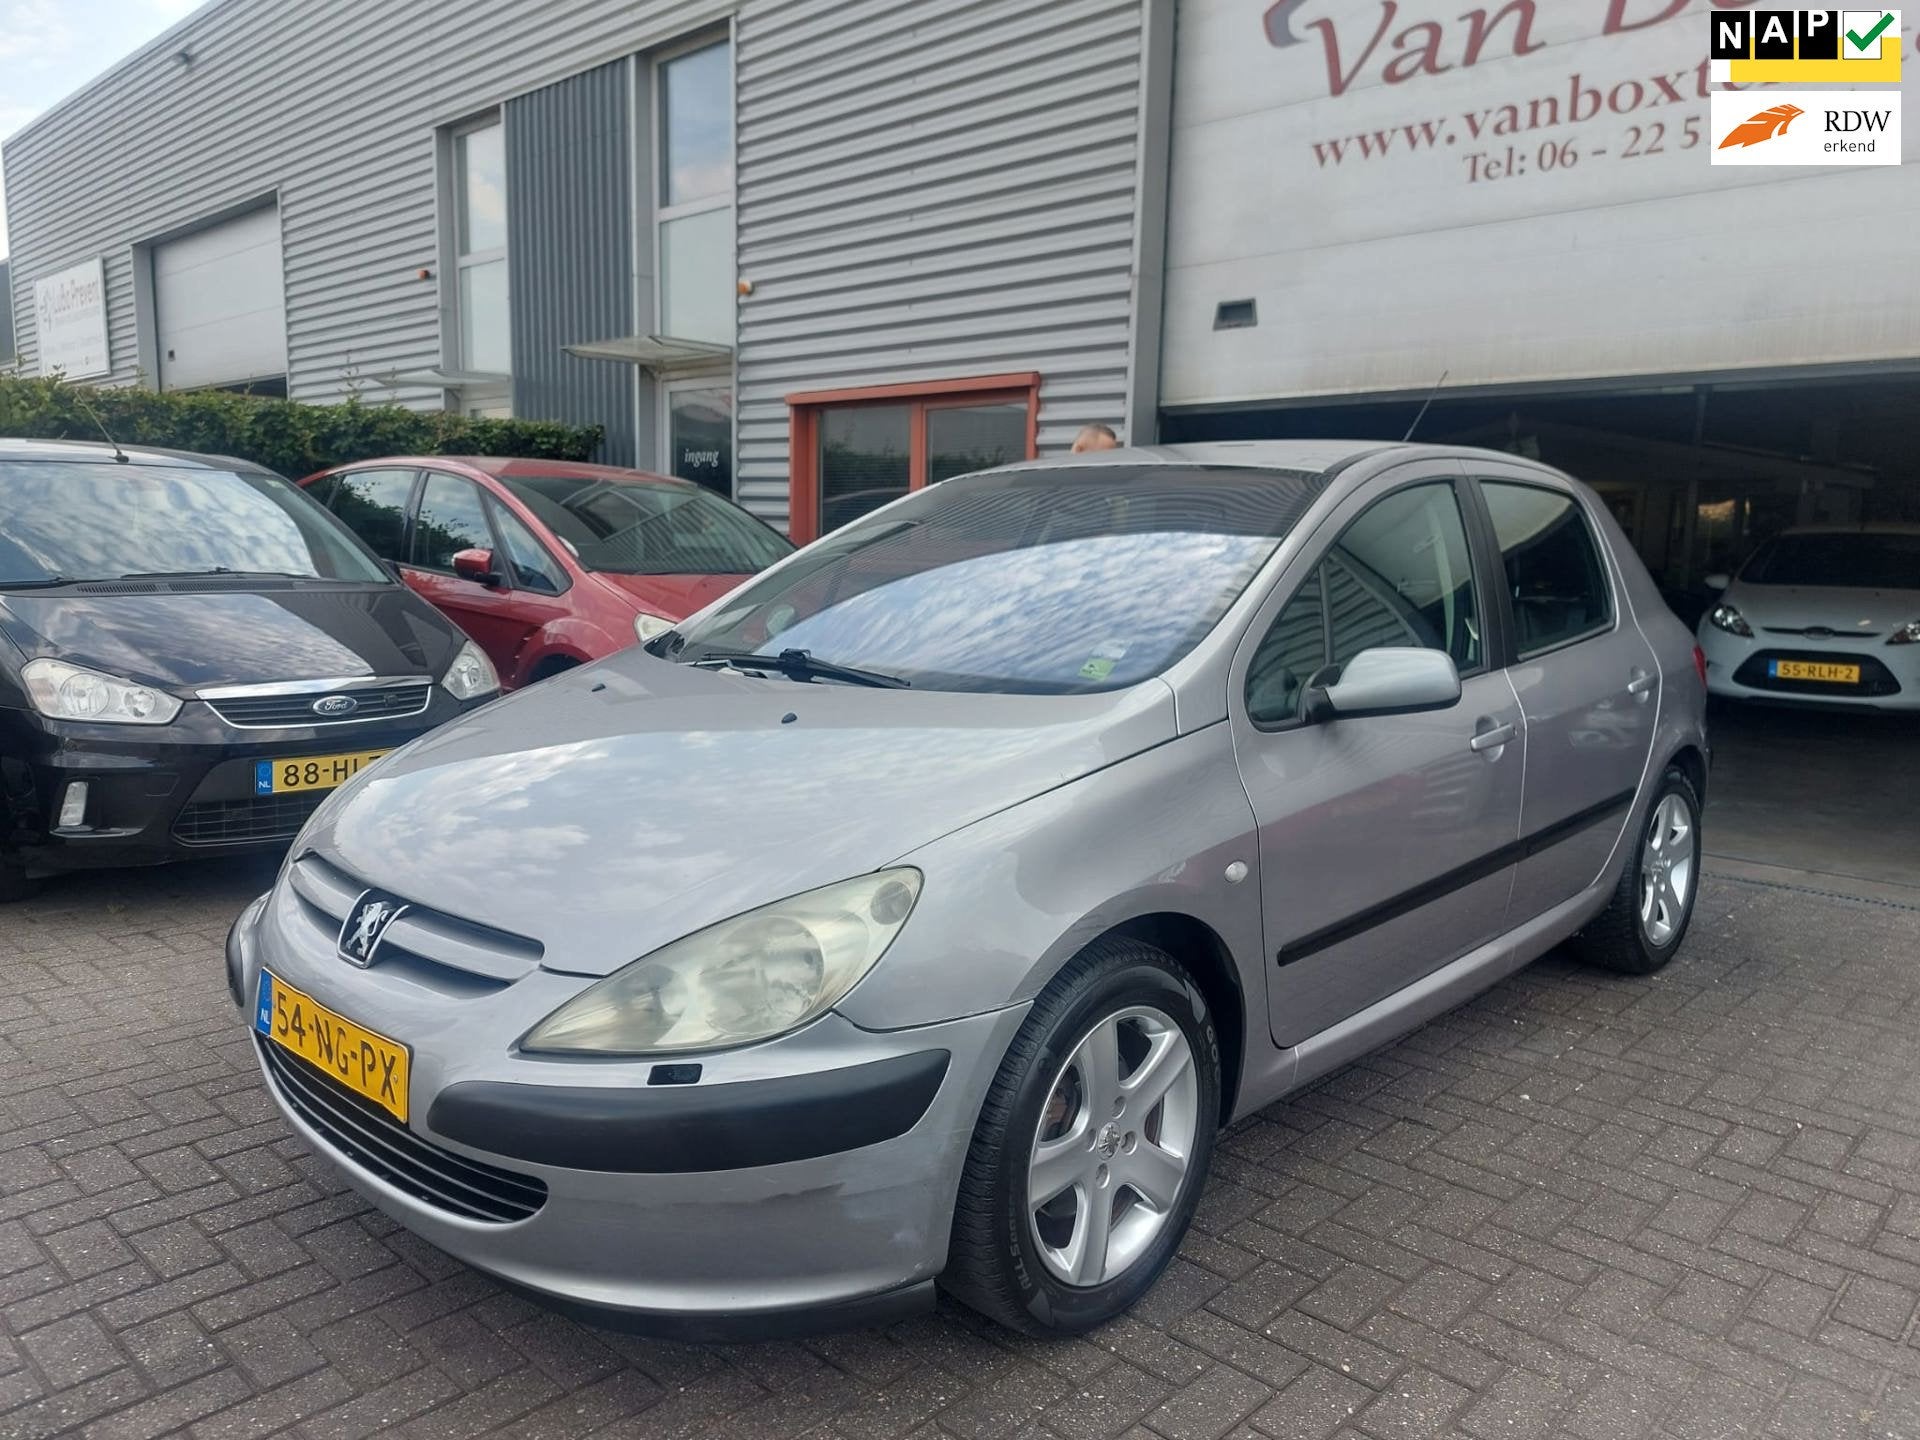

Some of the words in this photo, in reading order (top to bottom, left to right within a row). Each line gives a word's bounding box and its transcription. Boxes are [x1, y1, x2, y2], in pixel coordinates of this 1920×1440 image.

[1304, 0, 1547, 97] Van
[1312, 54, 1738, 168] www.vanboxt
[1463, 146, 1526, 182] Tel:
[1537, 138, 1579, 172] 06
[1621, 123, 1666, 159] 22
[1680, 116, 1706, 149] 5
[684, 448, 719, 467] ingang
[1781, 664, 1853, 680] 55-RLH-2
[324, 700, 348, 711] Ford
[260, 1008, 271, 1025] NL
[277, 991, 397, 1105] 54-NG-PX
